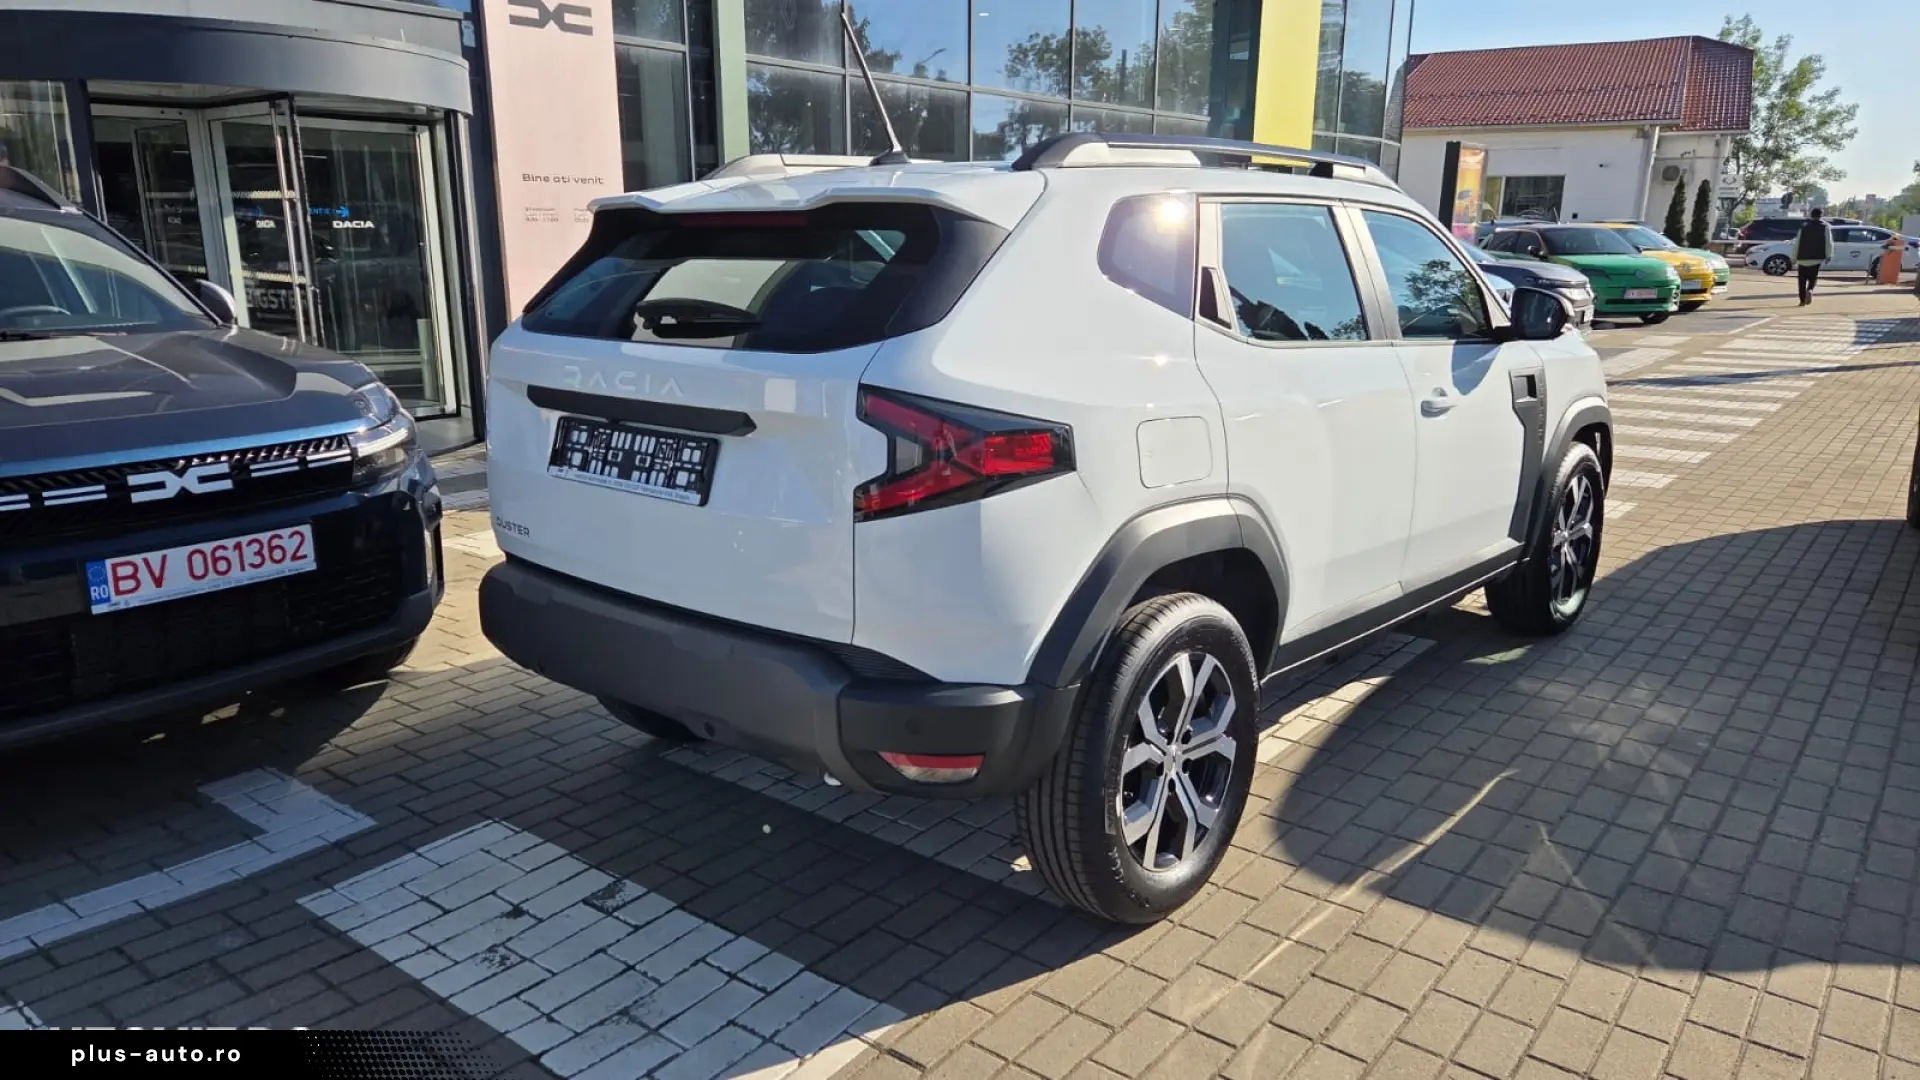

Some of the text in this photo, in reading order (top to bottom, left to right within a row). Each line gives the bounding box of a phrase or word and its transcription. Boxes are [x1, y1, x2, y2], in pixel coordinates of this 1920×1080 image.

[573, 175, 604, 185] venit
[332, 220, 375, 229] DACIA
[563, 364, 684, 397] DACIA
[111, 553, 168, 597] BV
[186, 530, 308, 581] 061362
[90, 585, 109, 601] RO
